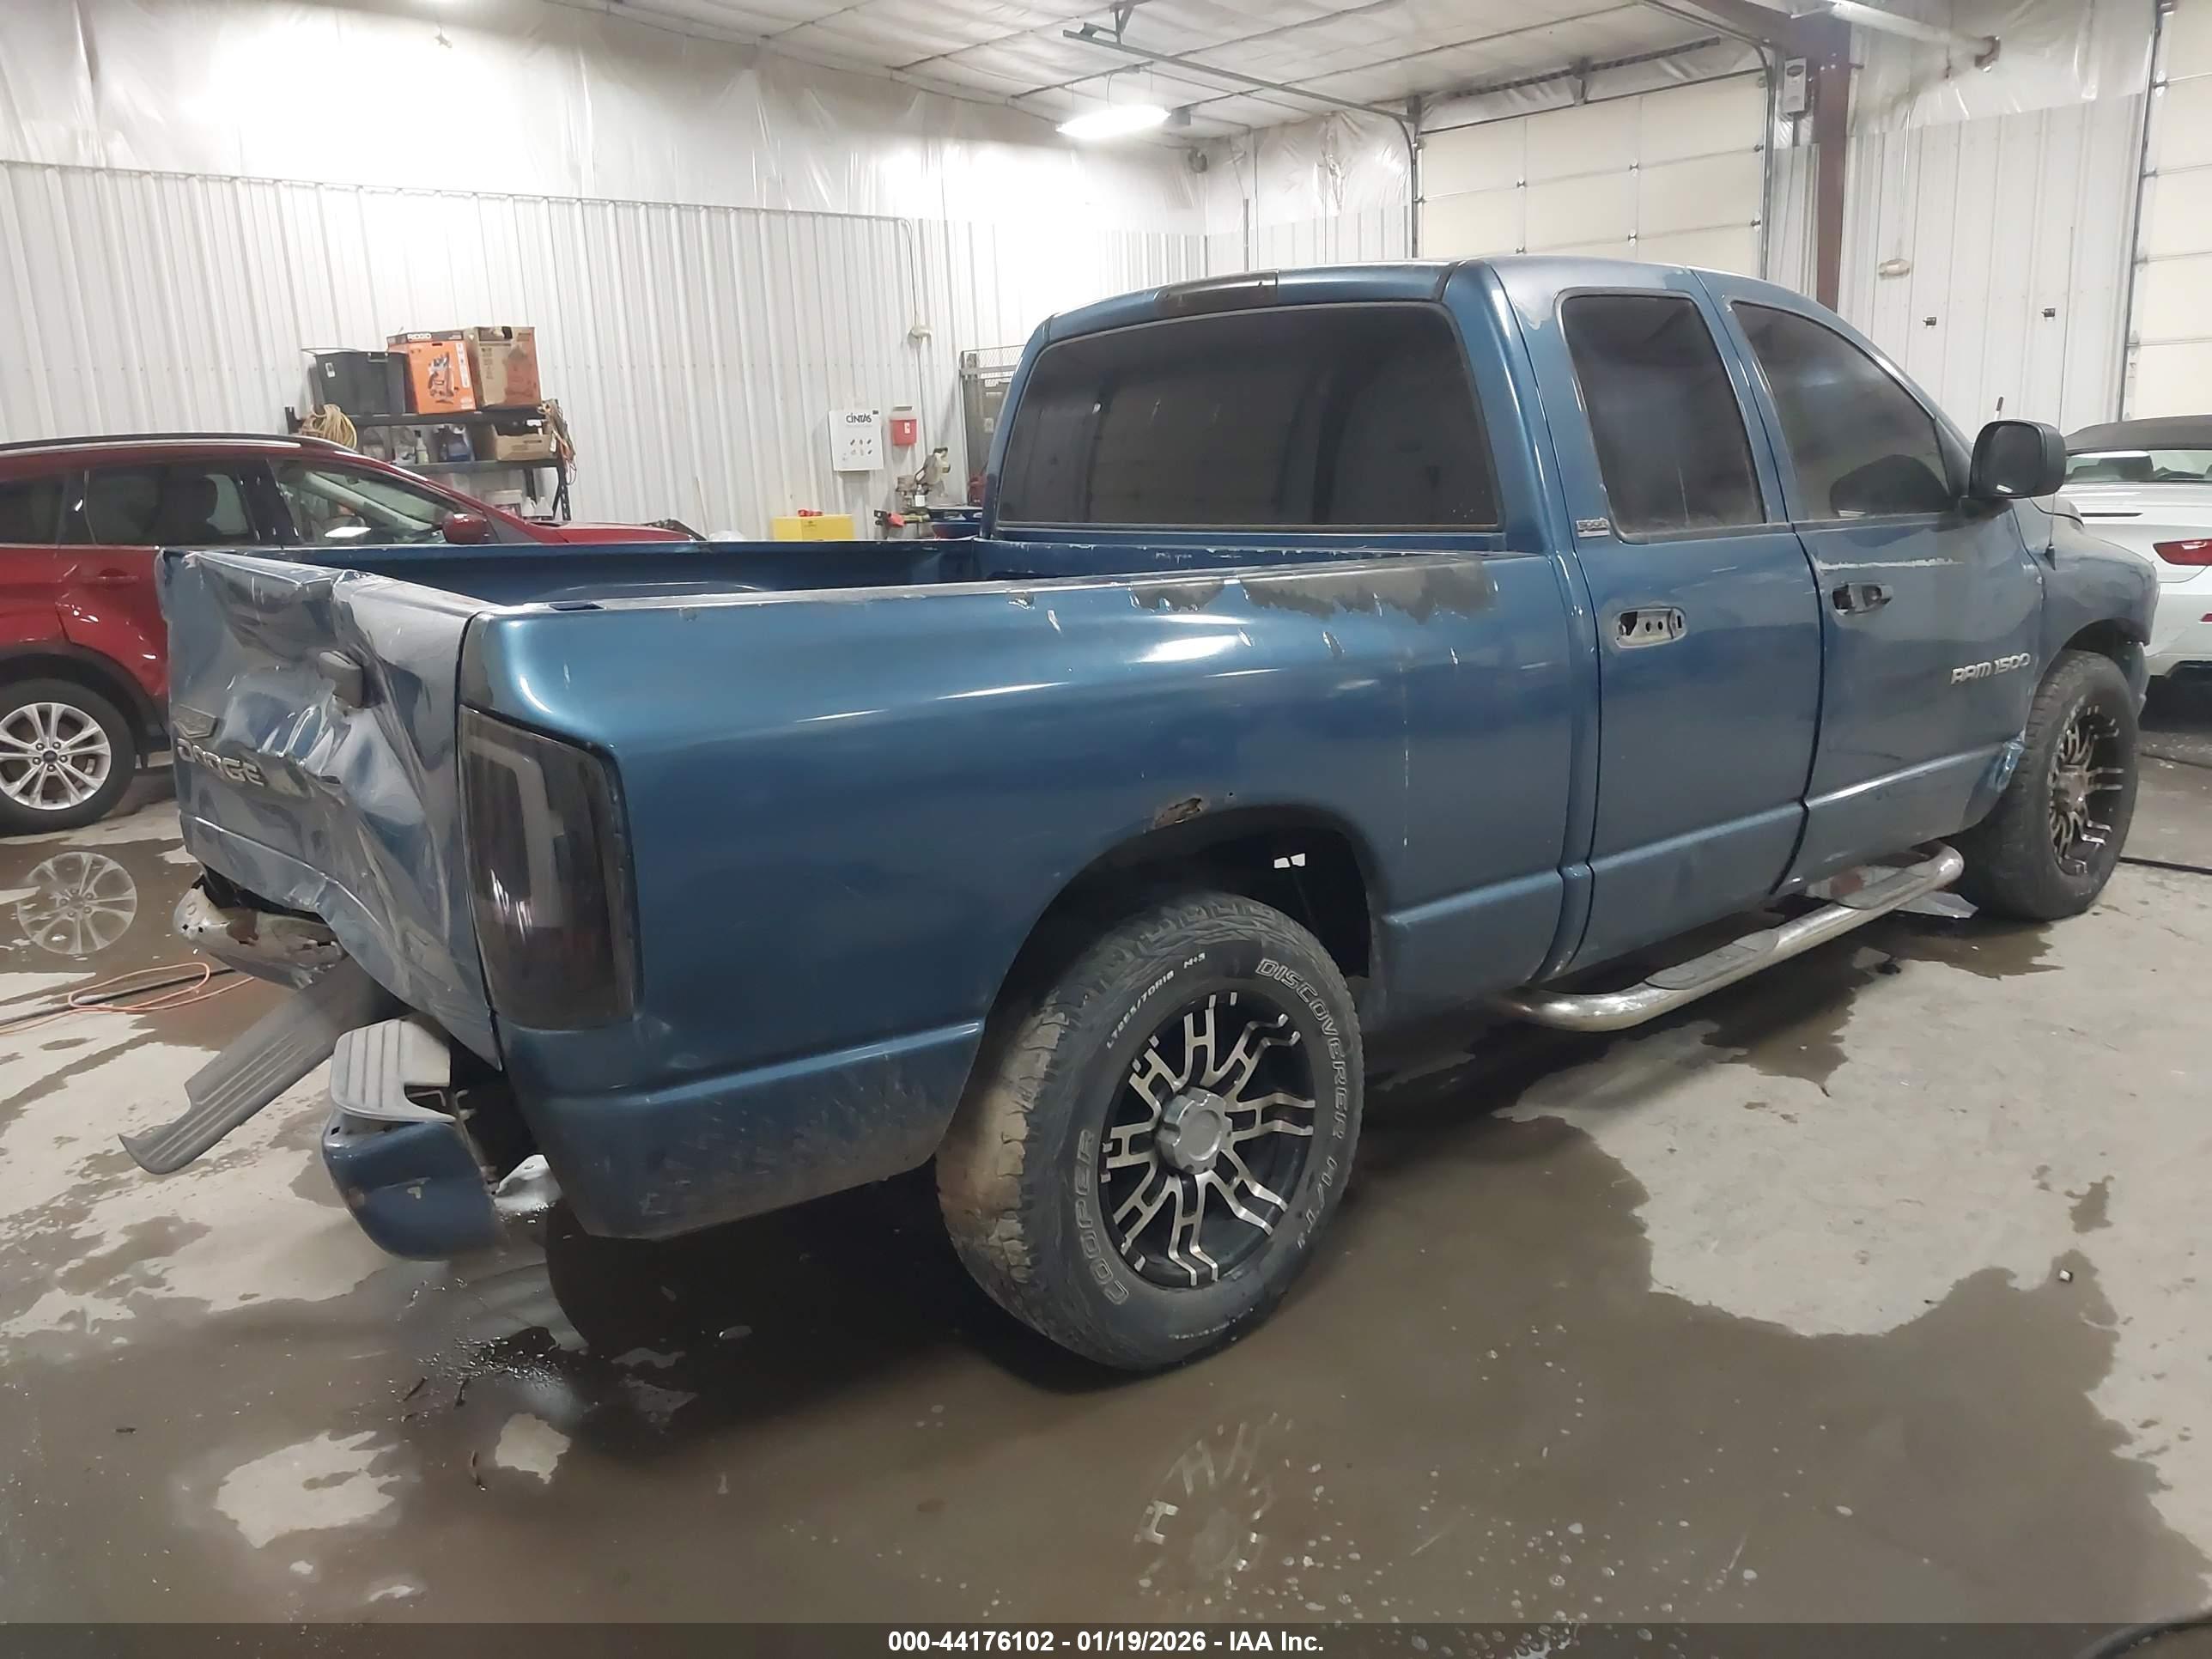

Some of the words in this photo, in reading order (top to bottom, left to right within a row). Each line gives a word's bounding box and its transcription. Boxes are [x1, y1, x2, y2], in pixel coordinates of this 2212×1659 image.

[1950, 662, 1992, 685] RAM
[1993, 653, 2031, 675] 1500
[1255, 957, 1347, 1140] DISCOVERER
[1074, 1129, 1129, 1305] COOPER
